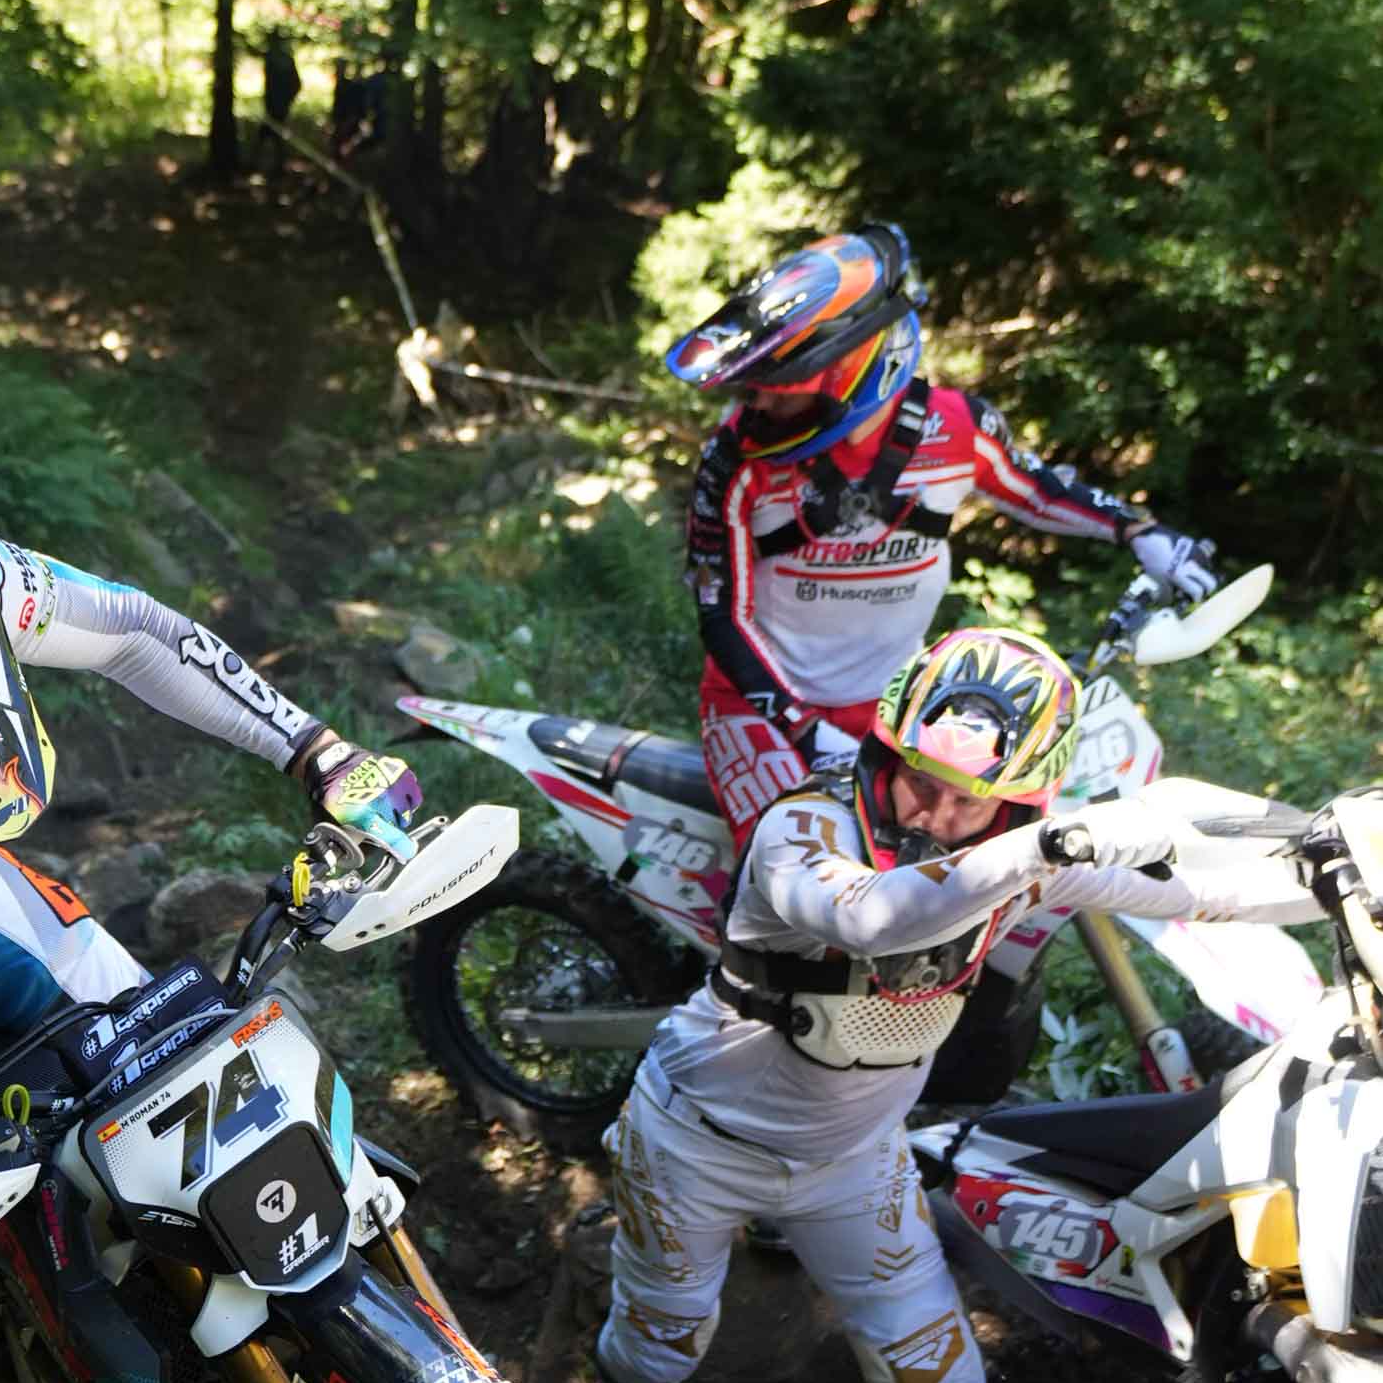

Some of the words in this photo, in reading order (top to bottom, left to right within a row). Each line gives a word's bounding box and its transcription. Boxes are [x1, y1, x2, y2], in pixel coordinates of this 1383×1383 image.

[821, 581, 918, 603] Husqvarna
[634, 825, 715, 872] 146
[129, 1099, 160, 1125] ROMAN
[146, 1048, 290, 1192] 74
[282, 1234, 331, 1275] GRIPPER
[1009, 1209, 1090, 1260] 145
